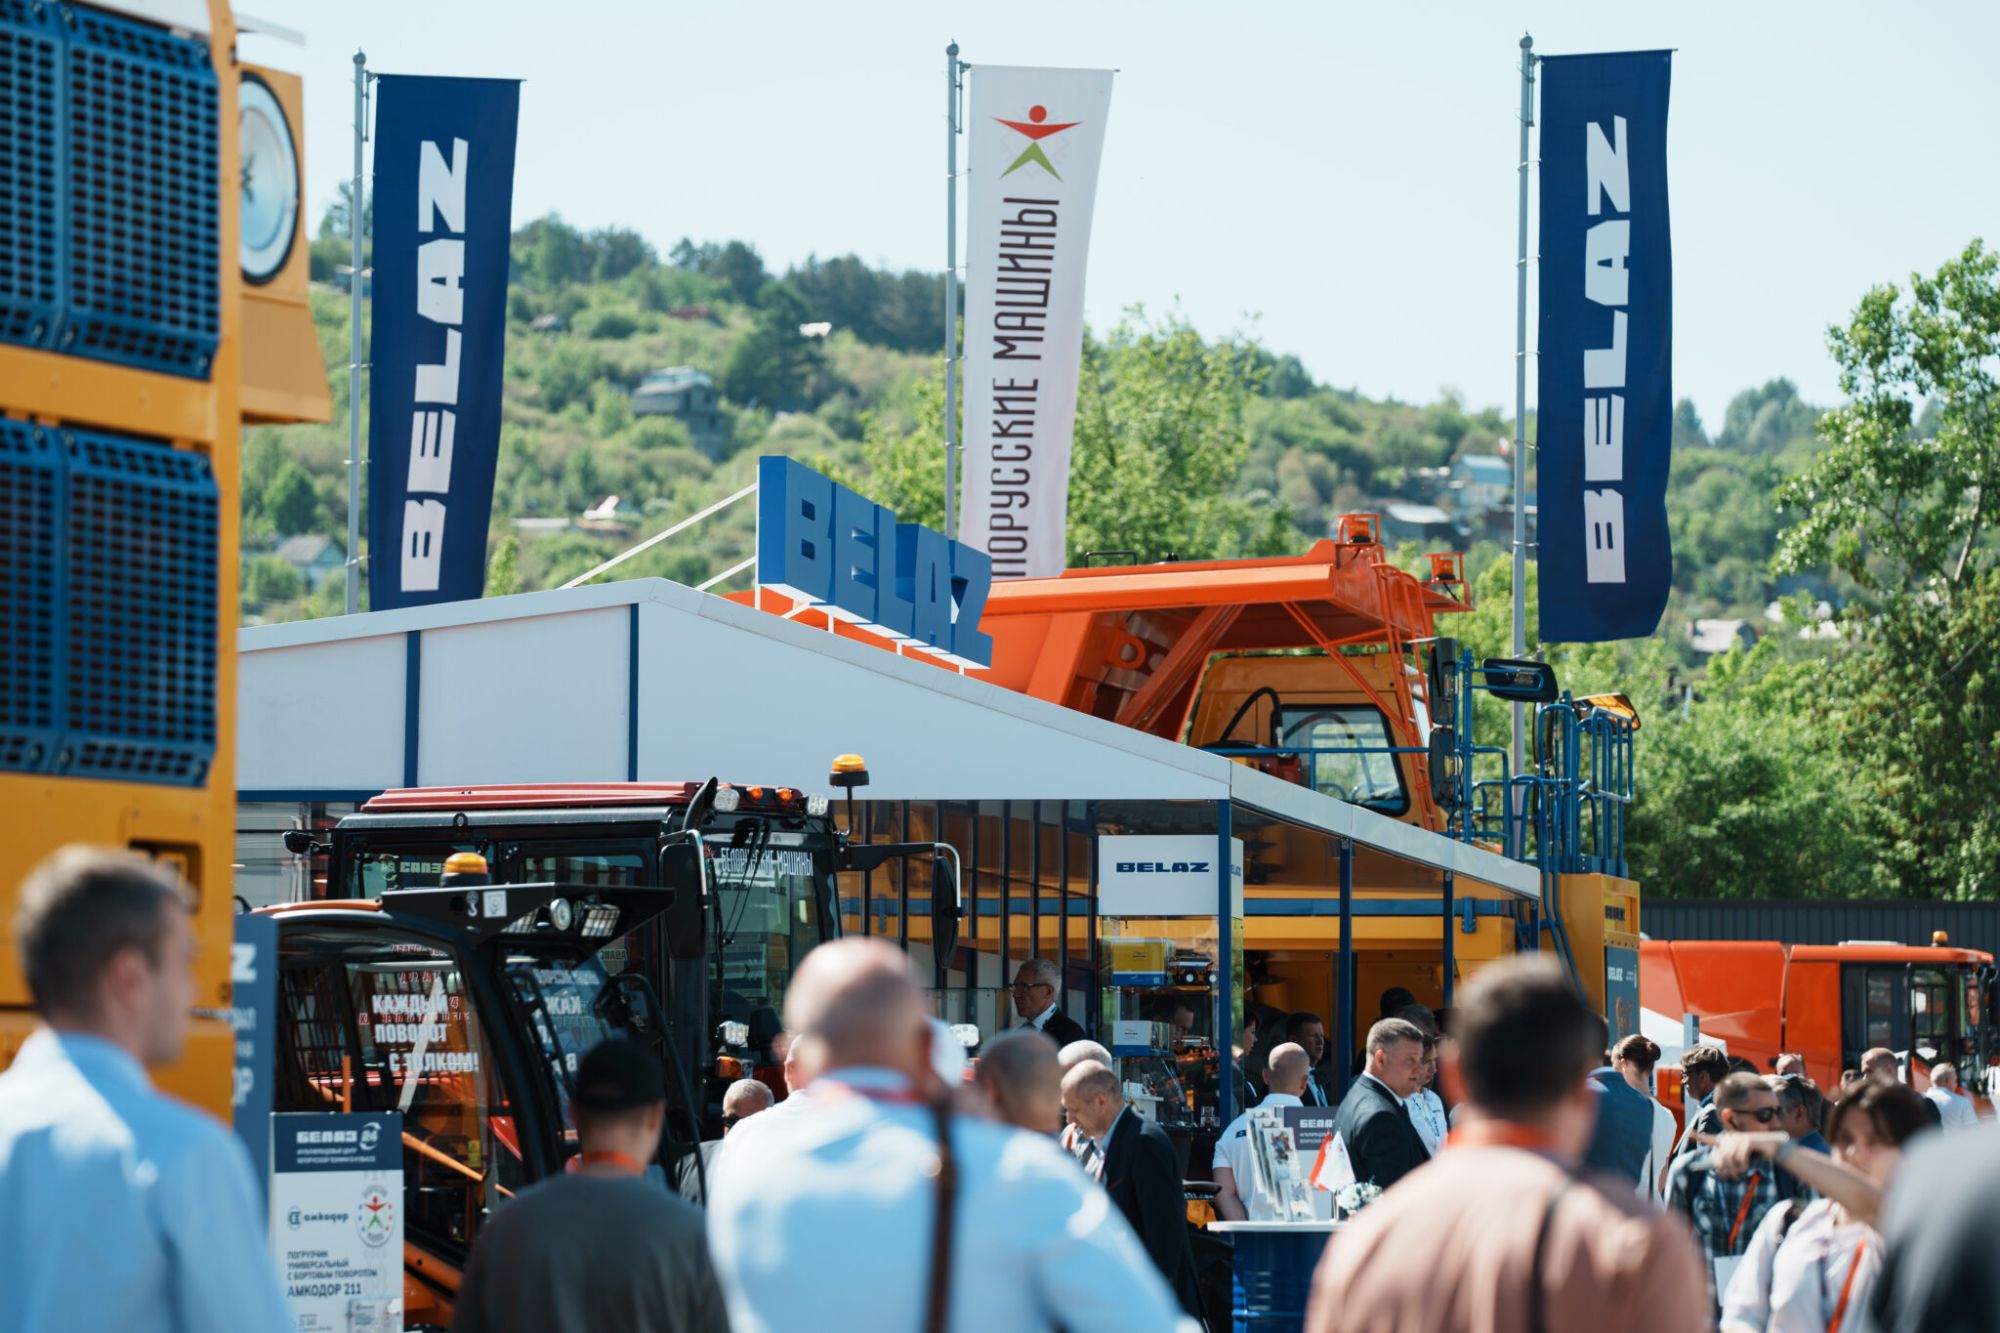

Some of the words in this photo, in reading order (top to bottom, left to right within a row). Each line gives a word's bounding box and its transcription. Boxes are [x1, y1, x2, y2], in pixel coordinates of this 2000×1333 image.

[992, 197, 1060, 360] МАШИНЫ
[1583, 114, 1630, 583] BELAZ
[401, 137, 468, 591] BELAZ
[987, 377, 1038, 576] ЛОРУССКИЕ
[759, 456, 993, 669] BELAZ
[1116, 862, 1209, 873] BELAZ
[296, 1130, 358, 1144] БЕЛАЗ
[1299, 1119, 1335, 1128] БЕЛА
[287, 1284, 342, 1298] АМКОДОР
[344, 1283, 361, 1295] 211
